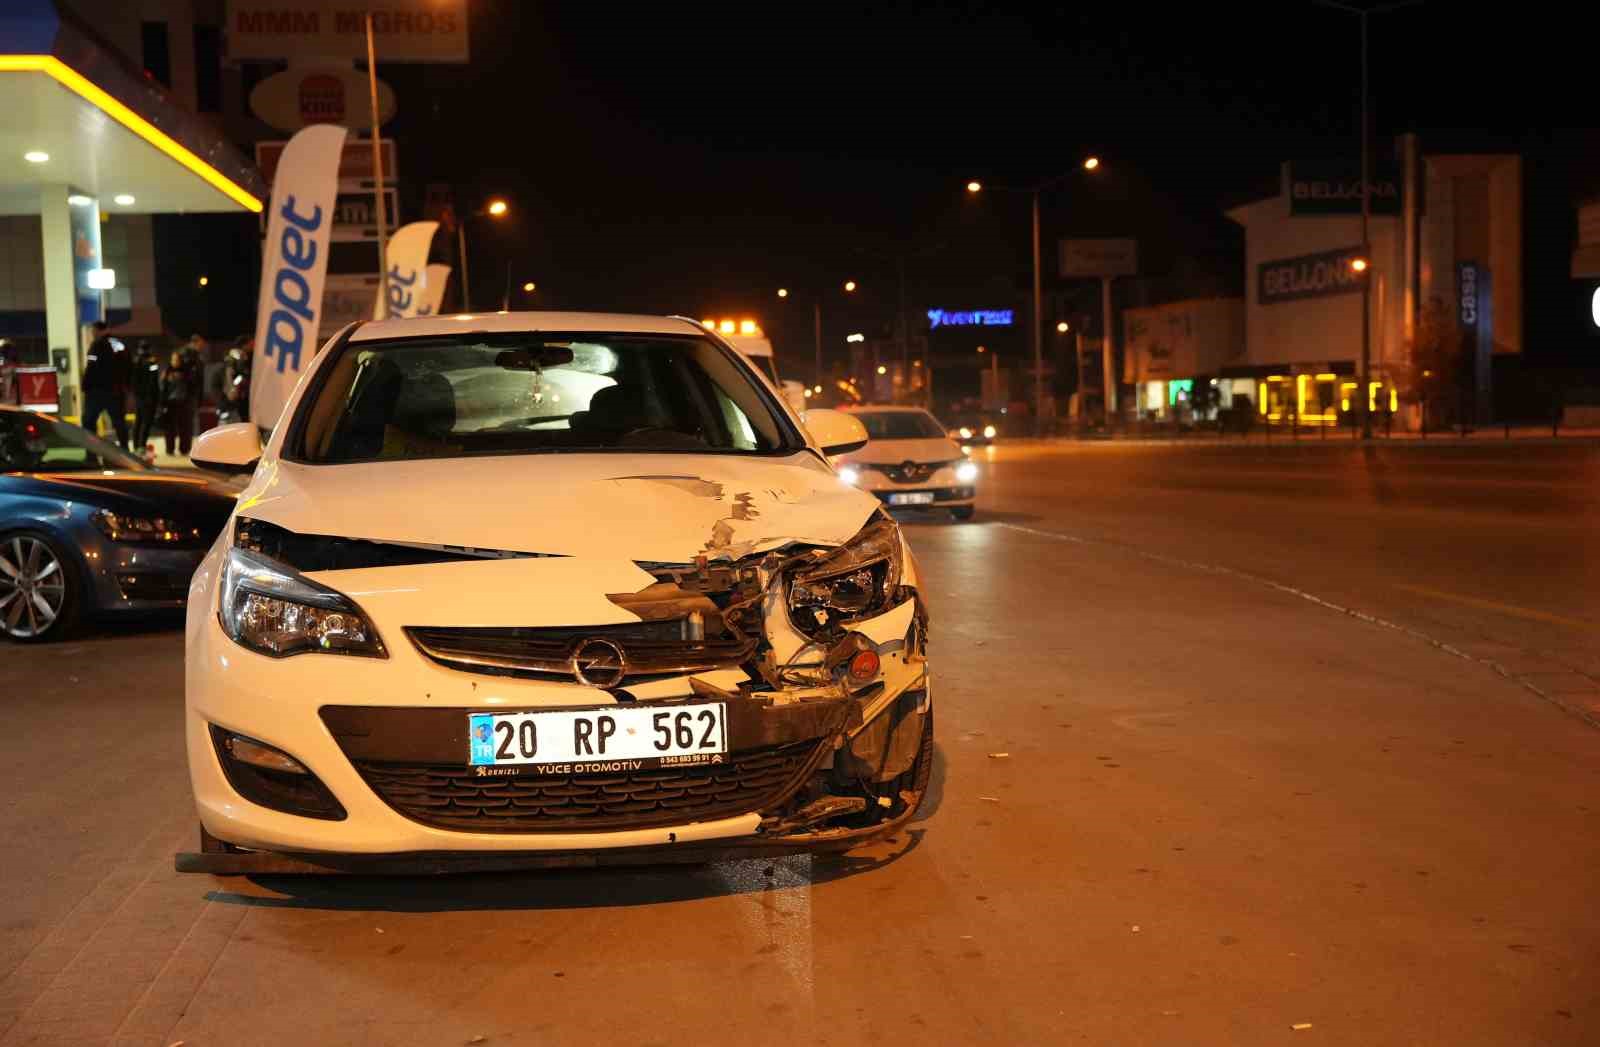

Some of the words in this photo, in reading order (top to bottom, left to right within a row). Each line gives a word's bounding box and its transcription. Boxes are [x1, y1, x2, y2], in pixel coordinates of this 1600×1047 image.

[237, 10, 318, 33] MMM
[476, 744, 493, 758] TR
[494, 720, 537, 760] 20
[574, 715, 616, 756] RP
[653, 709, 717, 751] 562
